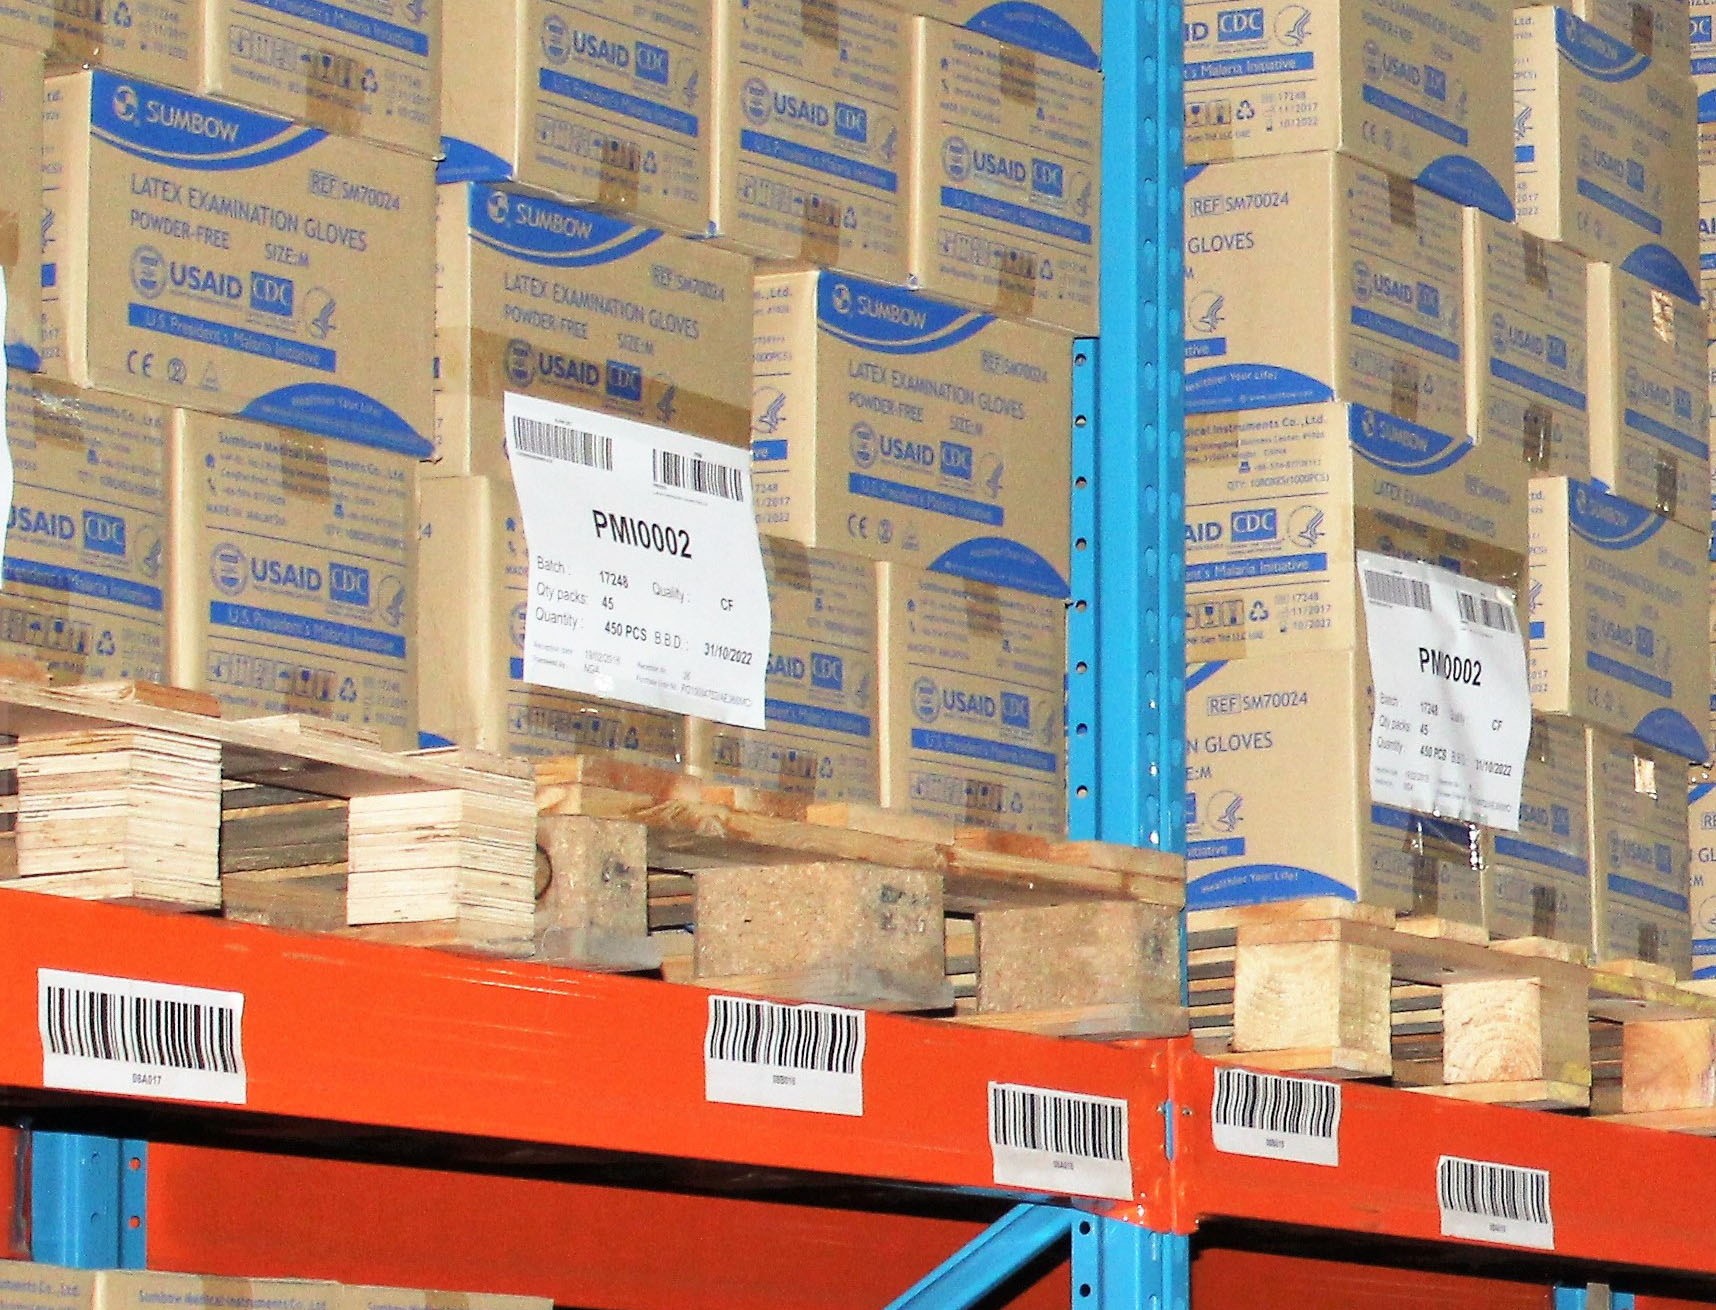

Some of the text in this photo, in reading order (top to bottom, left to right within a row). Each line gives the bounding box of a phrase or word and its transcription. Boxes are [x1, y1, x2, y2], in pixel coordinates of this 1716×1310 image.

[1219, 11, 1262, 33] CDC
[572, 30, 631, 70] USAID
[146, 99, 241, 142] SUMBOW
[773, 90, 829, 127] USAID
[971, 147, 1026, 184] USAID
[314, 172, 402, 211] REF SM70024
[1193, 192, 1289, 215] REF SM70024
[129, 208, 231, 250] POWDER-FREE
[130, 173, 367, 254] LATEX EXAMINATION GLOVES
[516, 202, 593, 239] SUMBOW
[1188, 232, 1254, 254] GLOVES
[168, 260, 293, 310] USAID CDC
[504, 272, 698, 340] LATEX EXAMINATION GLOVES
[856, 295, 927, 331] SUMBOW
[538, 349, 599, 386] USAID
[848, 360, 1026, 421] LATEX EXAMINATION GLOVES
[879, 425, 935, 466] USAID
[592, 509, 692, 559] PMI0002
[1186, 512, 1275, 543] AID CDC
[249, 554, 368, 599] USAID CDC
[537, 555, 734, 612] Batch 17248 Quality CF
[537, 582, 555, 597] Qty
[602, 597, 614, 611] 45
[535, 606, 754, 666] Quantity 450 PCS 31/10/2022
[941, 690, 996, 721] USAID
[1210, 691, 1309, 715] REF SM70024
[1205, 731, 1274, 754] GLOVES
